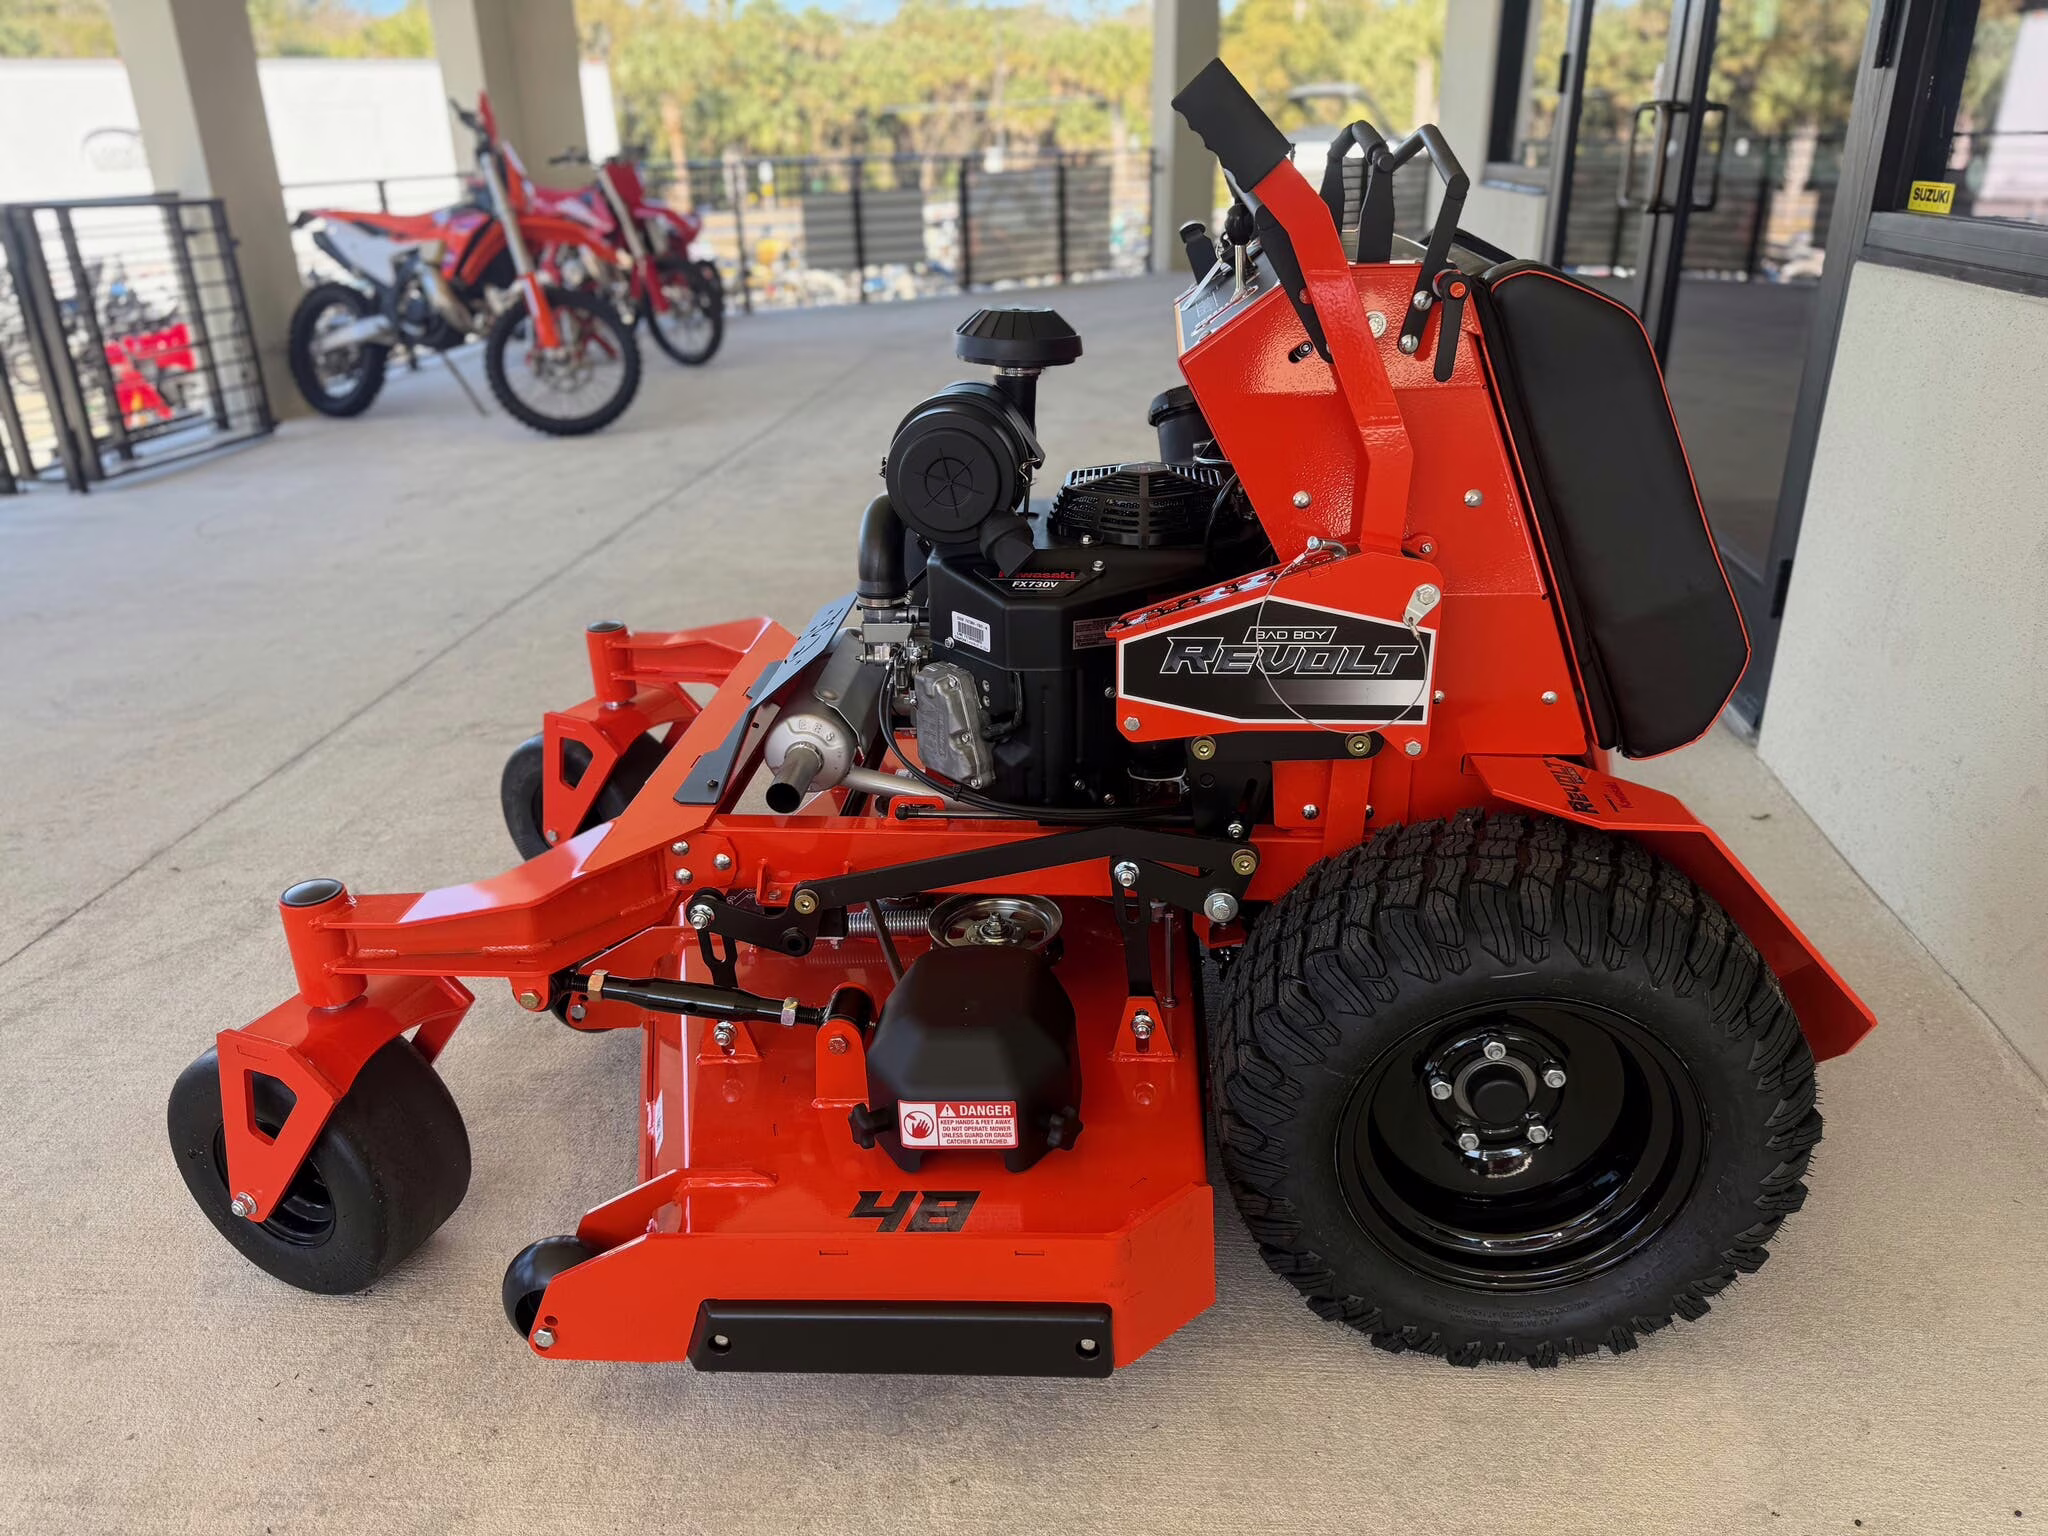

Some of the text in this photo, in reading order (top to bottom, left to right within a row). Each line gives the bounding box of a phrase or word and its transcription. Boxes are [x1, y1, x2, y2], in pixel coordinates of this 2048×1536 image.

[1913, 187, 1951, 204] SUZUKI
[1257, 630, 1328, 641] BAD BOY
[1160, 636, 1419, 675] REVOLT
[960, 1105, 1011, 1116] DANGER
[848, 1190, 982, 1233] 48
